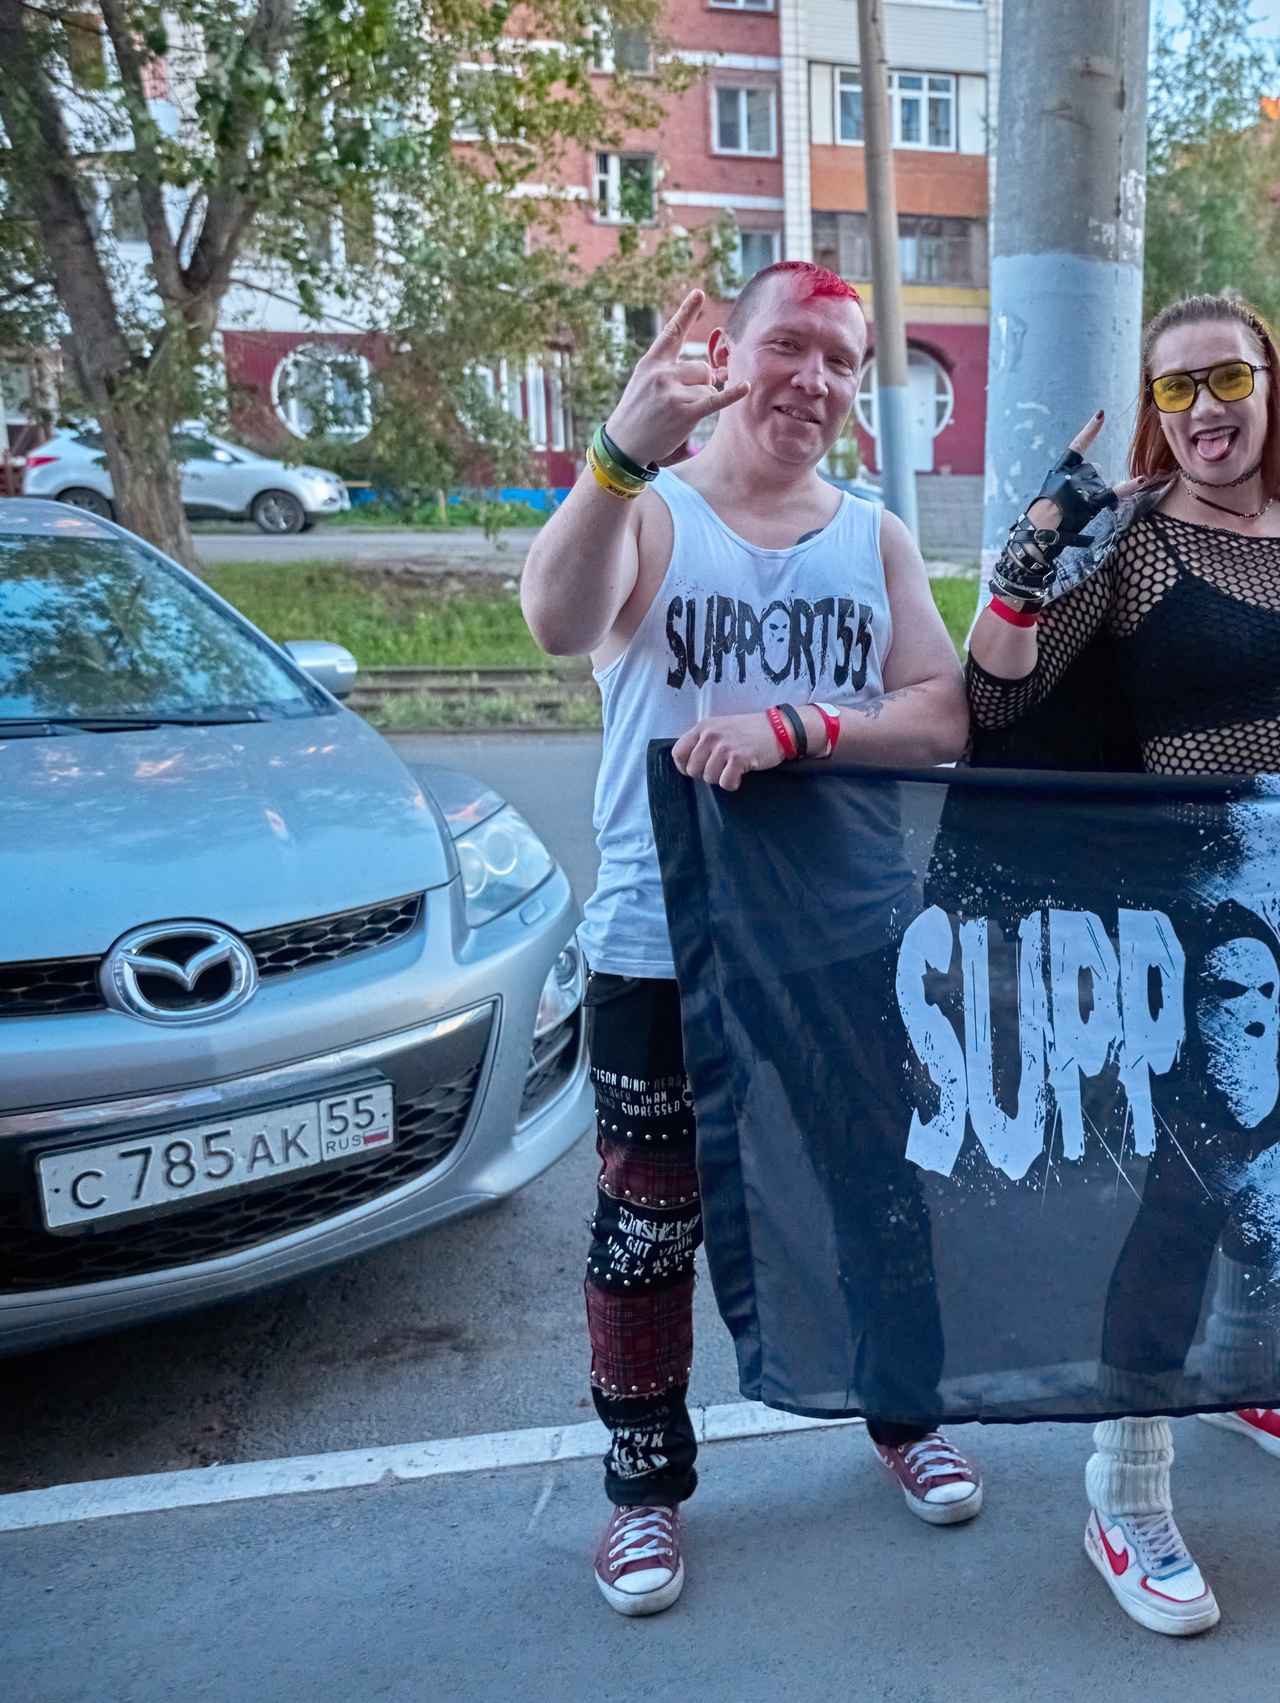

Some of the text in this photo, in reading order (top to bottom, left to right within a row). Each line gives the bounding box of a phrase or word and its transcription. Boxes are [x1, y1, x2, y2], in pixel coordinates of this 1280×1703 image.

[666, 594, 873, 692] SUPPORT55
[326, 1094, 376, 1135] 55
[325, 1134, 363, 1154] RUS
